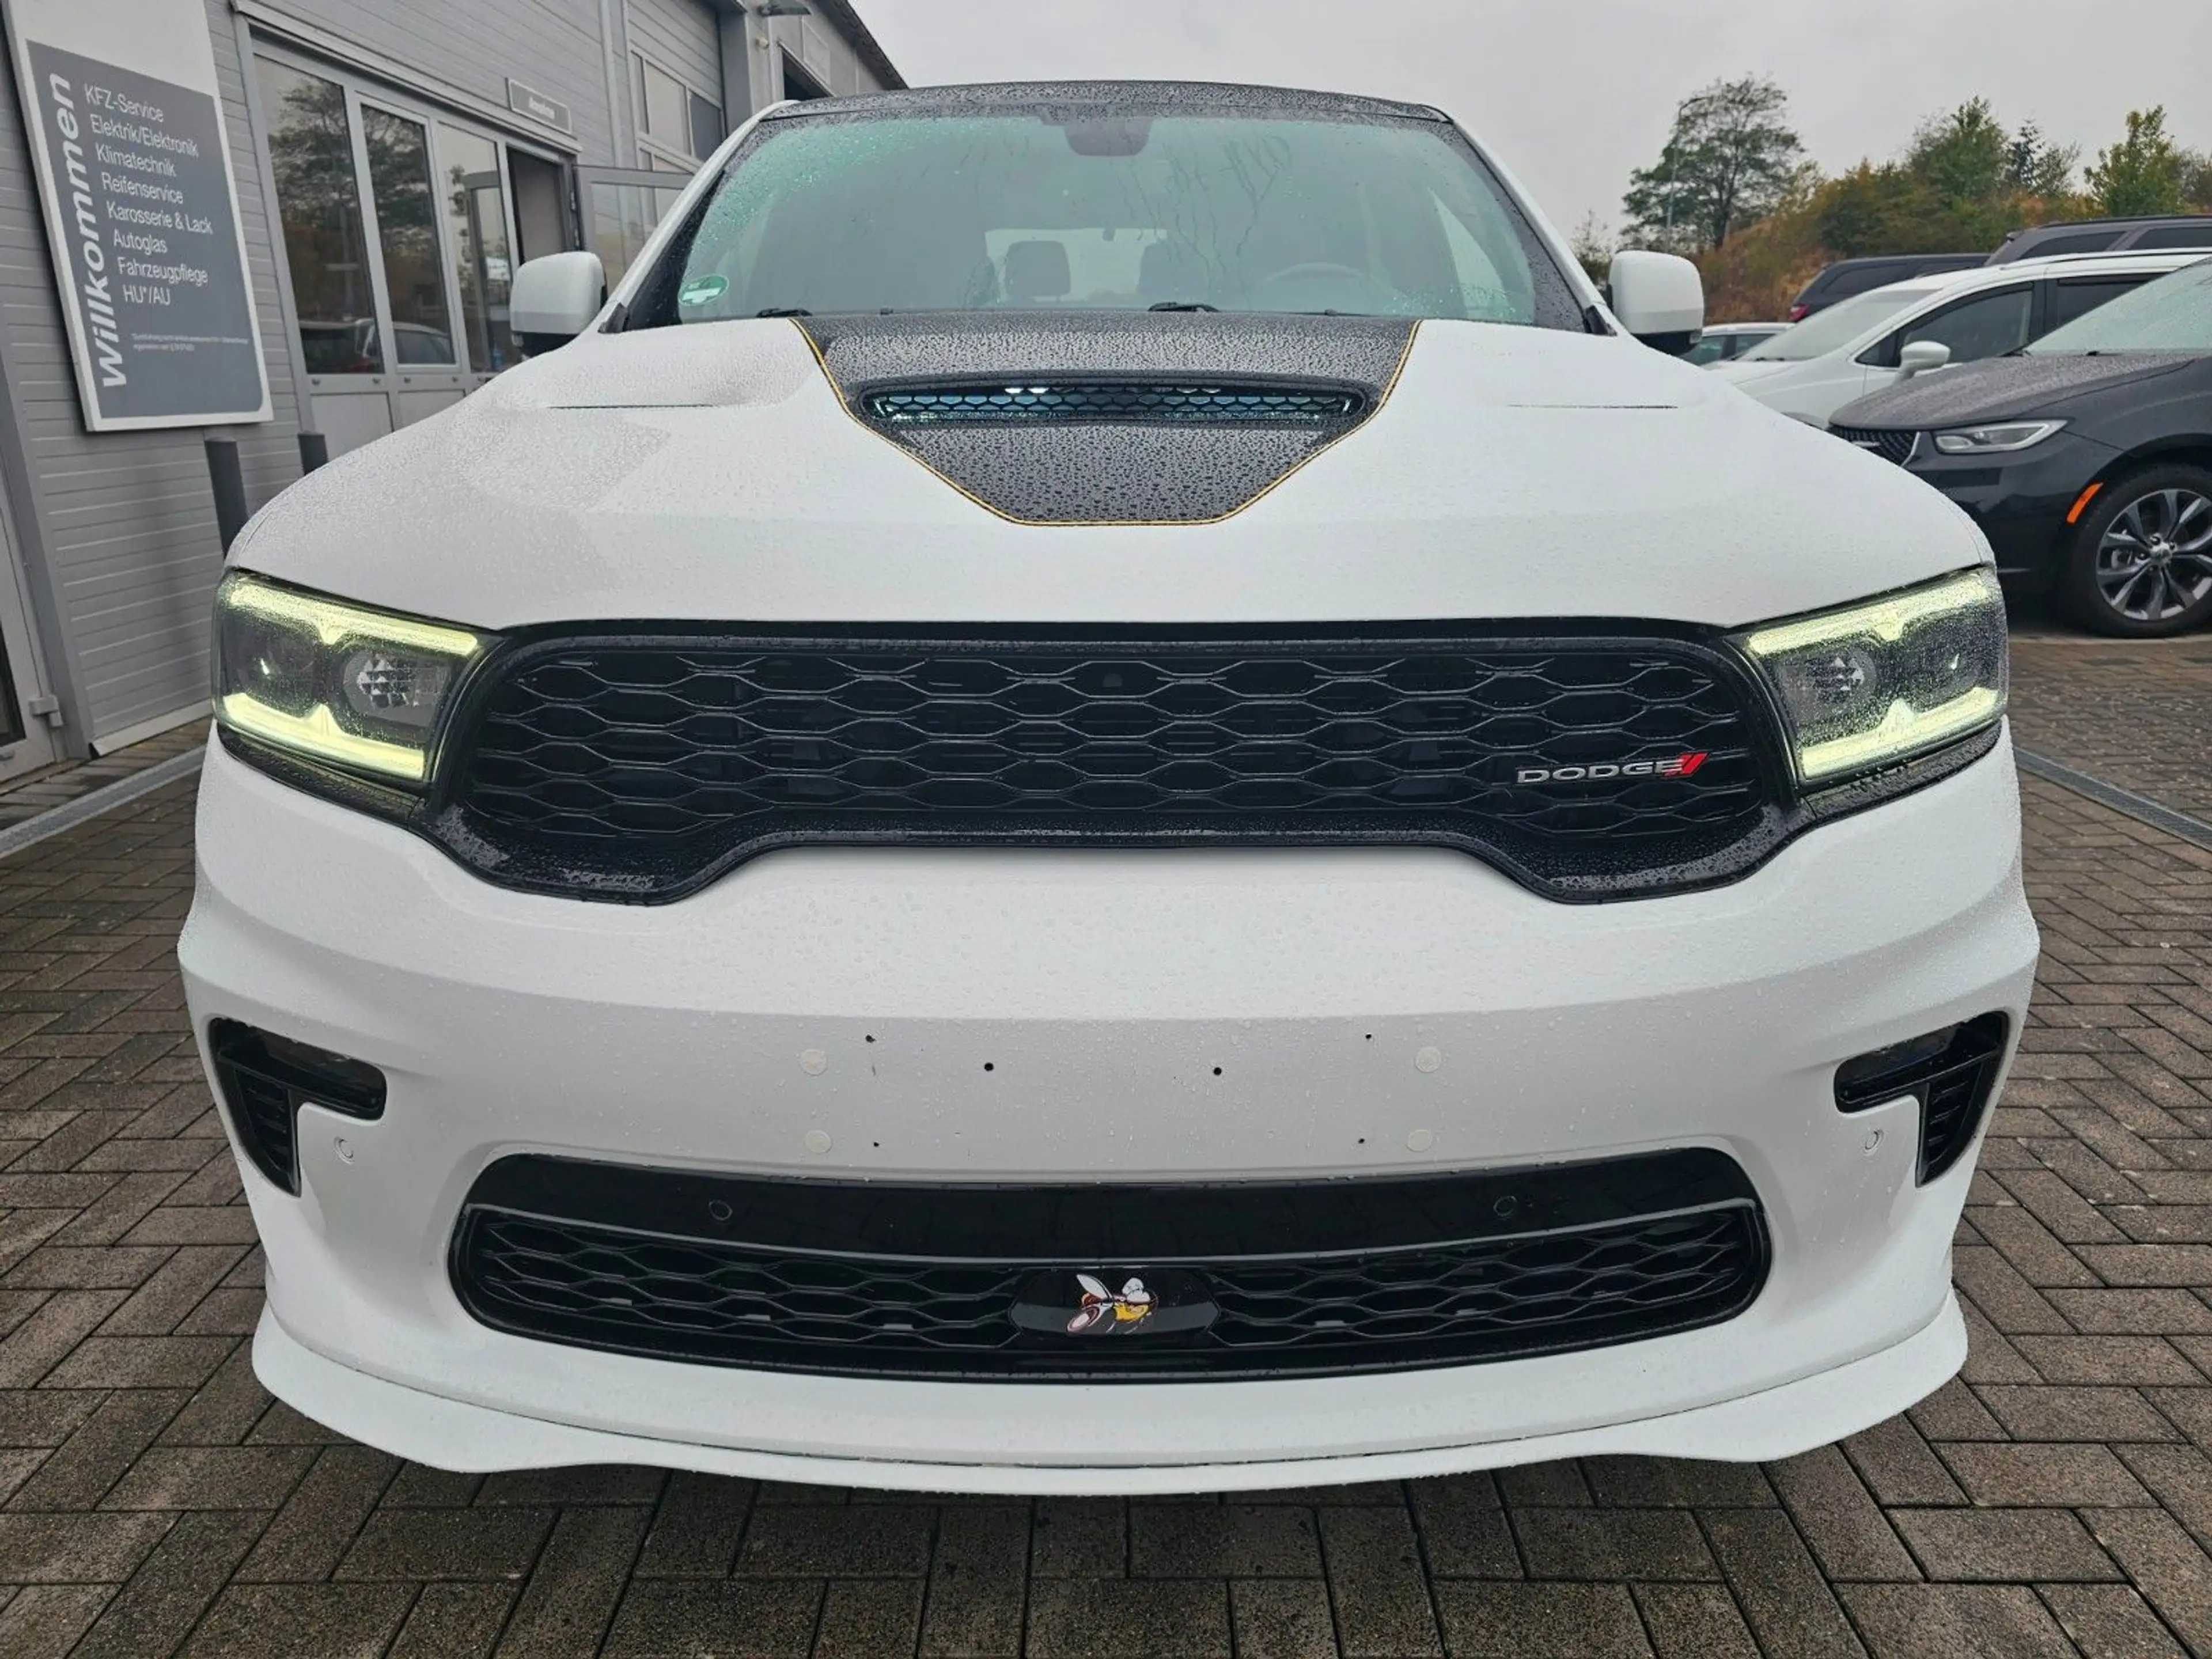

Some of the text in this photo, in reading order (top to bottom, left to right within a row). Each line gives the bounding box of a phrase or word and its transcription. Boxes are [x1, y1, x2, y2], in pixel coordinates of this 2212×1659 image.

[84, 84, 164, 123] KFZ-Service
[89, 113, 199, 158] Elektrik/Elektronik
[95, 142, 176, 177] Klimatechnik
[101, 172, 183, 204] Reifenservice
[50, 73, 127, 387] willkommen
[106, 200, 213, 234] Karosserie & Lack
[113, 229, 168, 255] Autoglas
[118, 256, 208, 287] Fahrzeugpflege
[1517, 759, 1683, 783] DODGE
